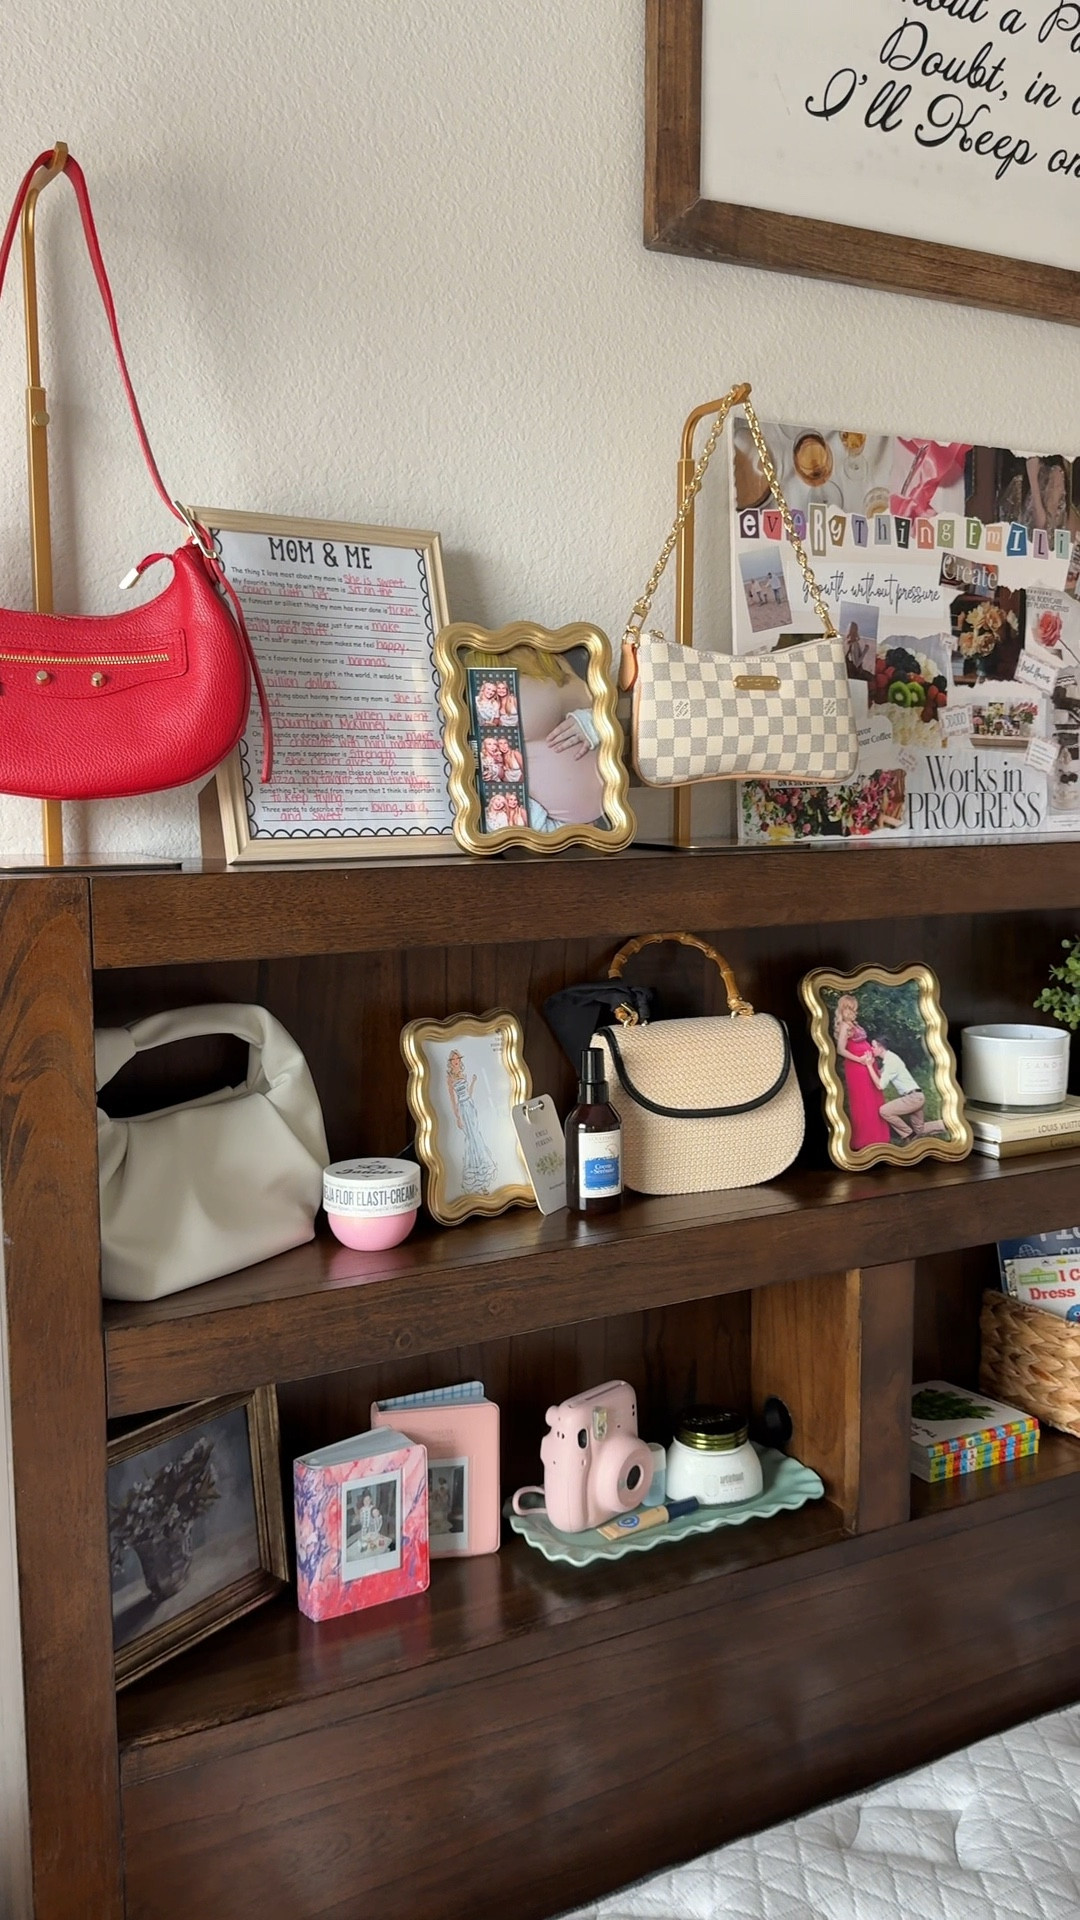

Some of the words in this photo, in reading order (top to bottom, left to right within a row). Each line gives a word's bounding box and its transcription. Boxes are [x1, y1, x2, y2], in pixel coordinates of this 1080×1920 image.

[999, 9, 1027, 34] a
[880, 17, 1008, 101] Doubt,
[1024, 71, 1062, 108] in
[805, 68, 912, 132] I'll
[914, 93, 1038, 180] Keep
[268, 537, 315, 564] MOM
[322, 542, 339, 567] &
[344, 545, 372, 569] ME
[244, 569, 260, 577] thing
[267, 569, 278, 577] love
[943, 553, 998, 590] Create
[269, 581, 286, 589] thing
[802, 570, 848, 603] gowth
[851, 572, 898, 605] without
[896, 582, 940, 614] pressure
[270, 618, 291, 626] special
[371, 621, 400, 632] make
[286, 711, 309, 719] memory
[301, 732, 319, 740] during
[871, 732, 892, 743] Coffee
[925, 755, 998, 792] Works
[1003, 761, 1023, 792] in
[409, 787, 434, 795] important
[280, 811, 302, 821] and
[908, 792, 1041, 830] PROGRESS
[1038, 1123, 1058, 1134] LOUIS
[336, 1189, 354, 1206] FLOR
[356, 1184, 415, 1207] ELASTI-CREAM
[1058, 1270, 1067, 1282] I
[1029, 1287, 1076, 1300] Dress
